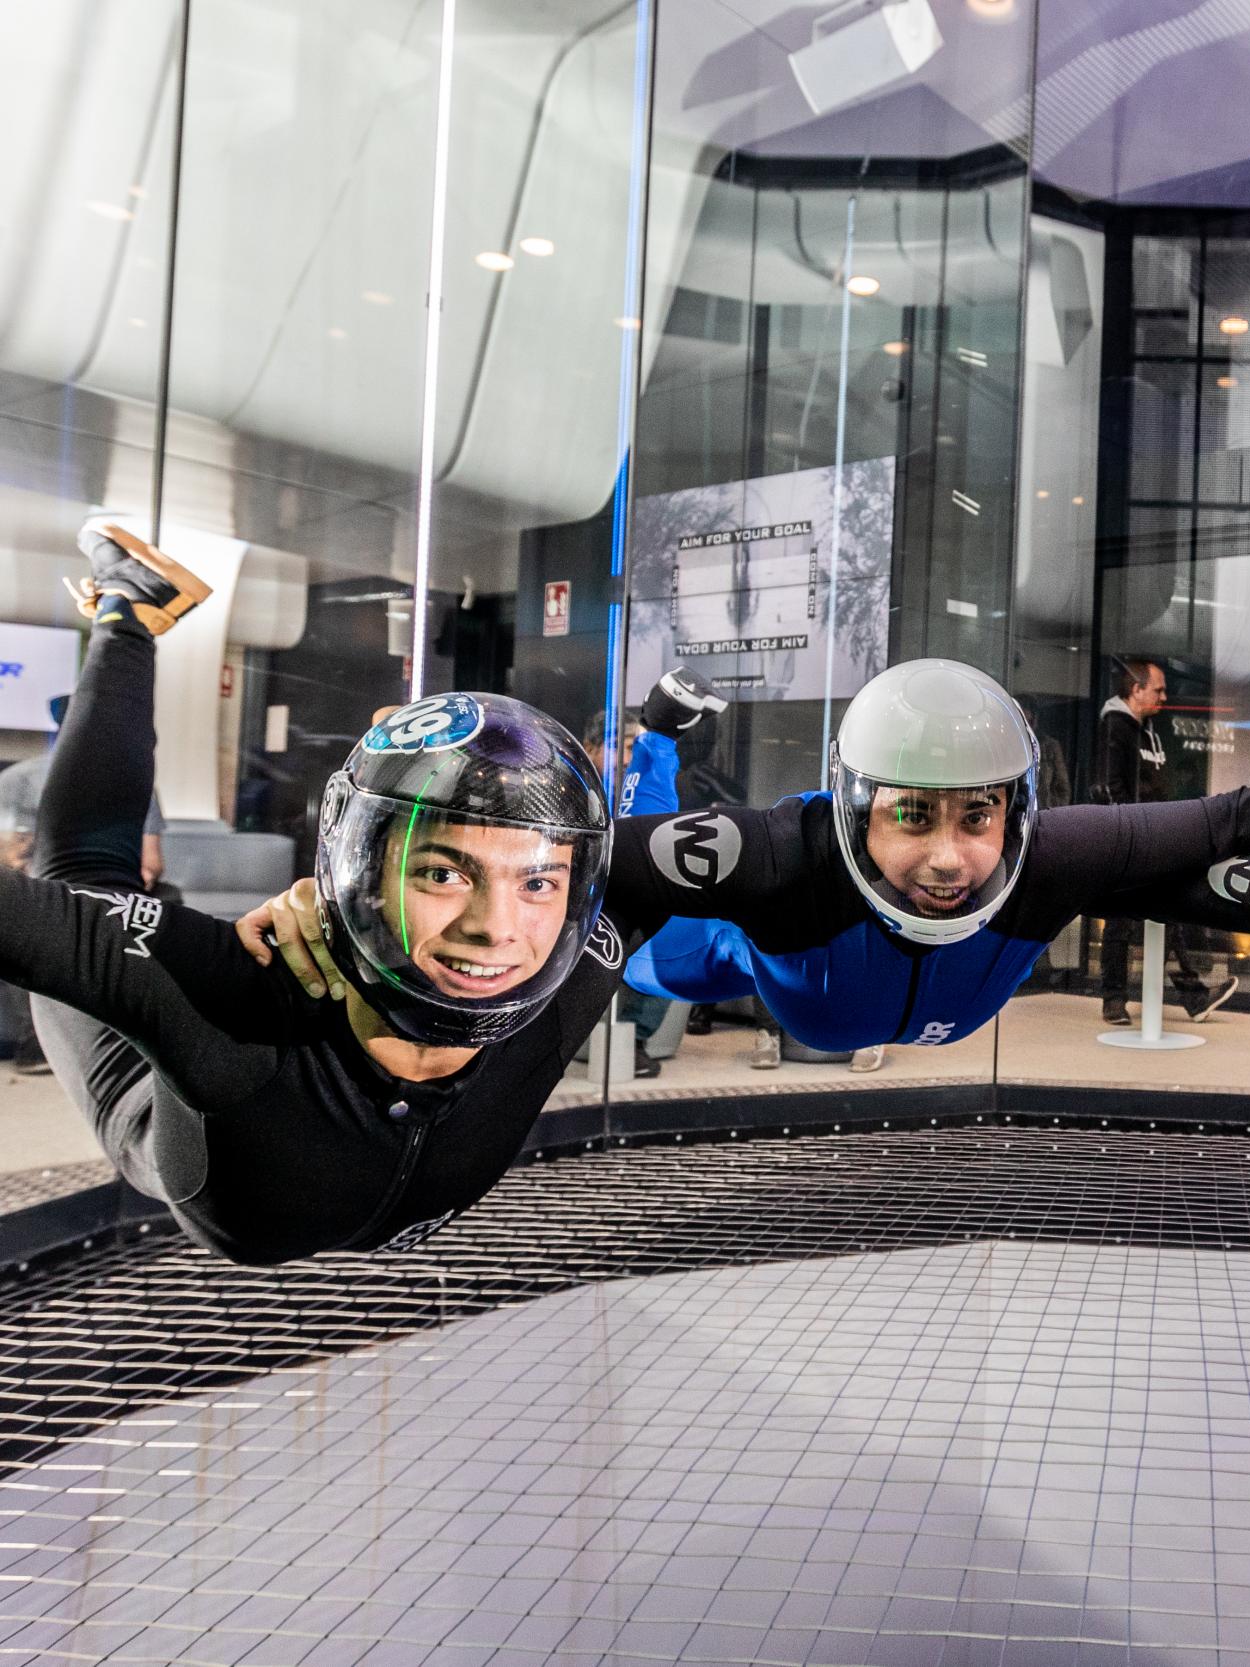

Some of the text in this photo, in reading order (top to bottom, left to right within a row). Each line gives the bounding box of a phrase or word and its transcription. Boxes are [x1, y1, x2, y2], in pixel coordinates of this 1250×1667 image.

[680, 522, 811, 549] AIM FOR YOUR GOAL
[807, 595, 815, 616] ON
[677, 636, 806, 656] AIM FOR YOUR GOAL
